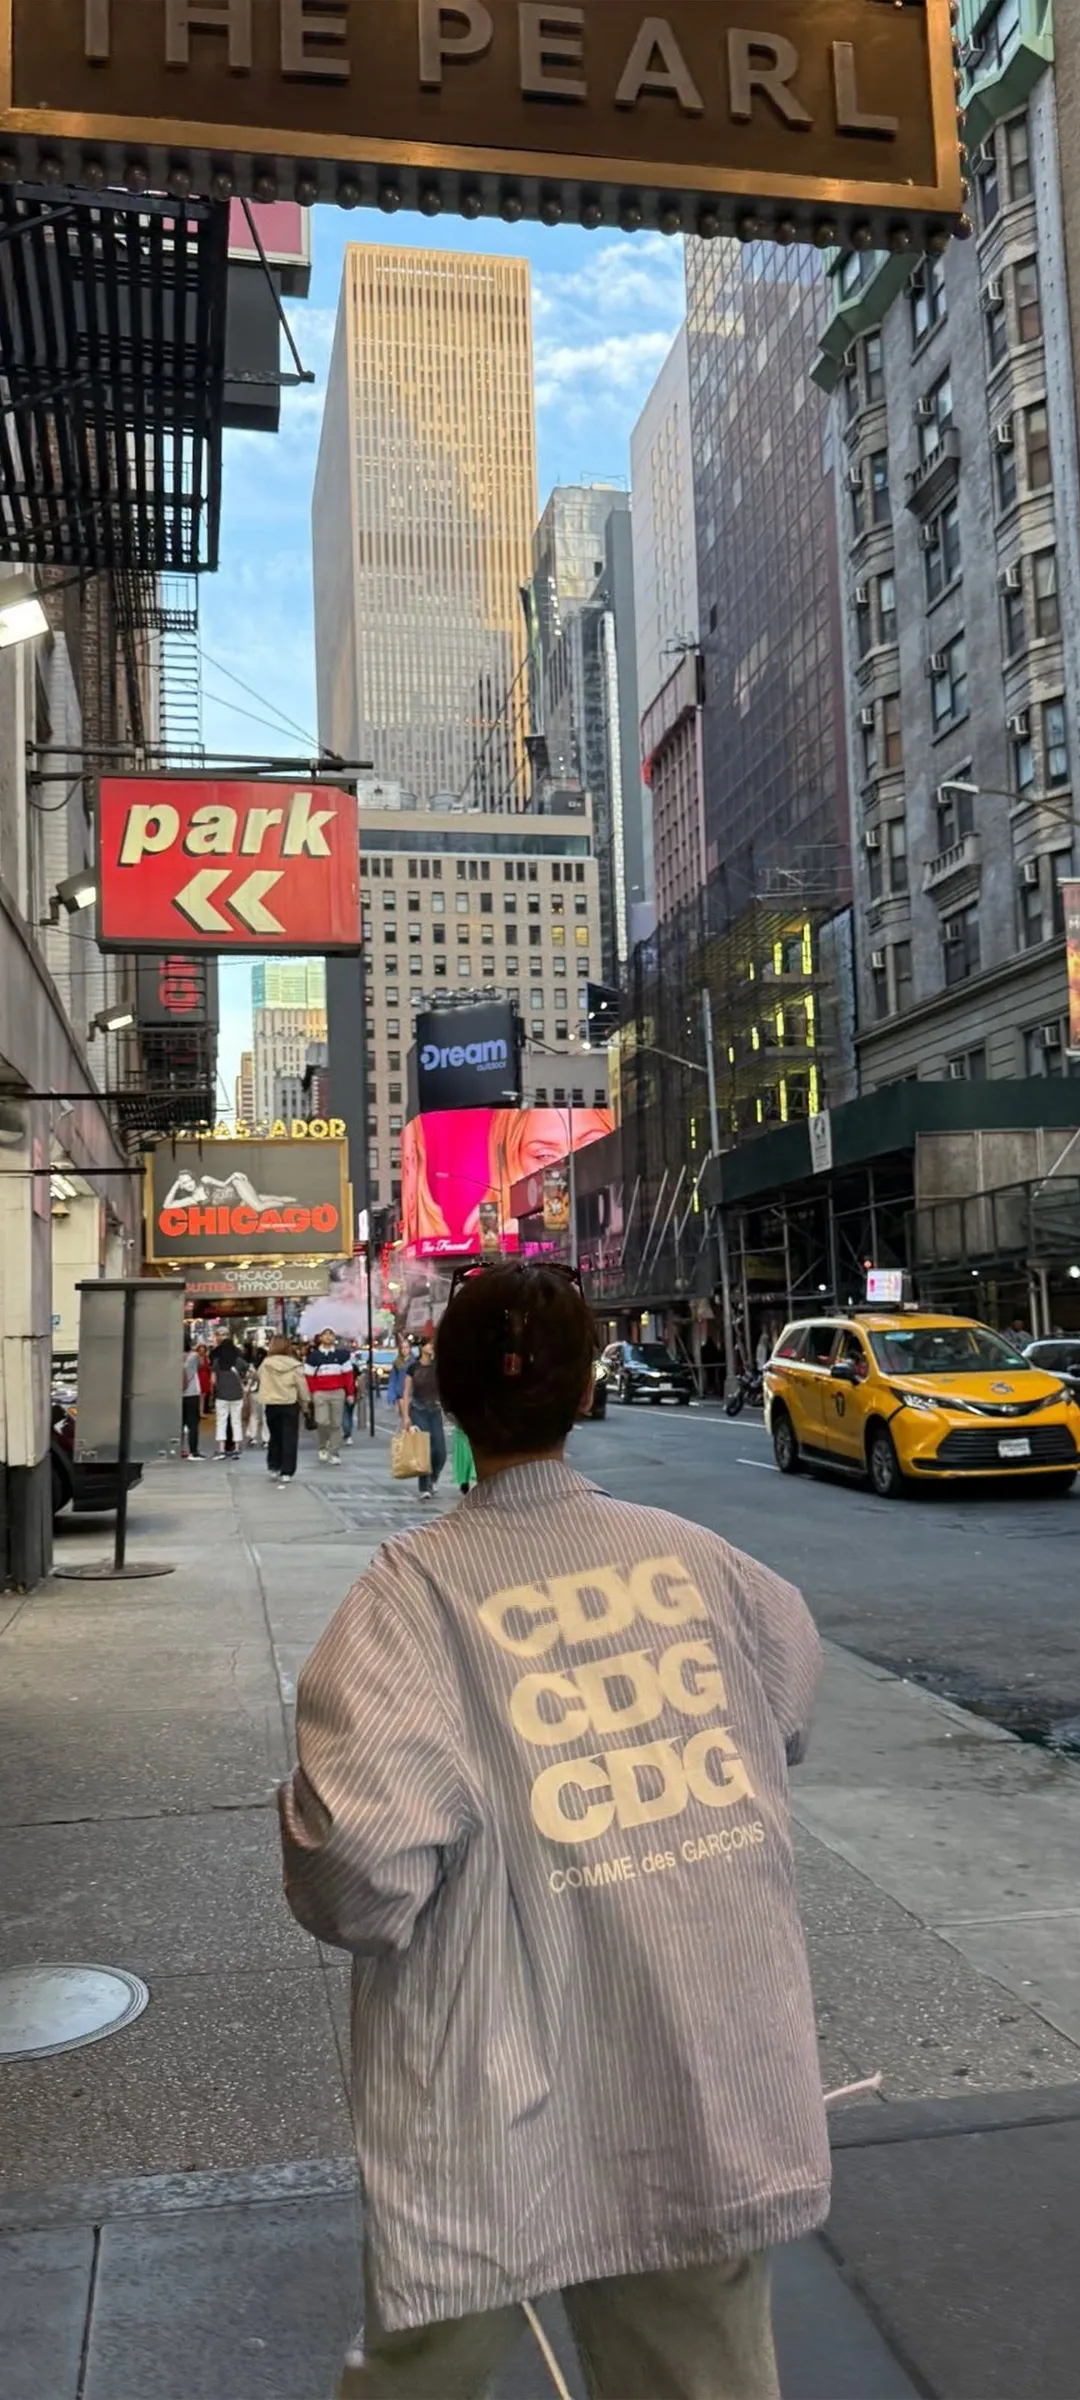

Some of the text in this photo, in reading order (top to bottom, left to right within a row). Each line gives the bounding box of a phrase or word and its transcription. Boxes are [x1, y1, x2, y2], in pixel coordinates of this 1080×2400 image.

[85, 0, 898, 136] THE PEARL
[119, 792, 338, 867] park
[420, 1038, 508, 1071] Dream
[158, 1202, 339, 1237] CHICAGO
[478, 1556, 711, 1658] CDG
[509, 1639, 729, 1746] CDG
[531, 1725, 756, 1844] CDG
[550, 1856, 637, 1894] COMME
[642, 1849, 677, 1874] des
